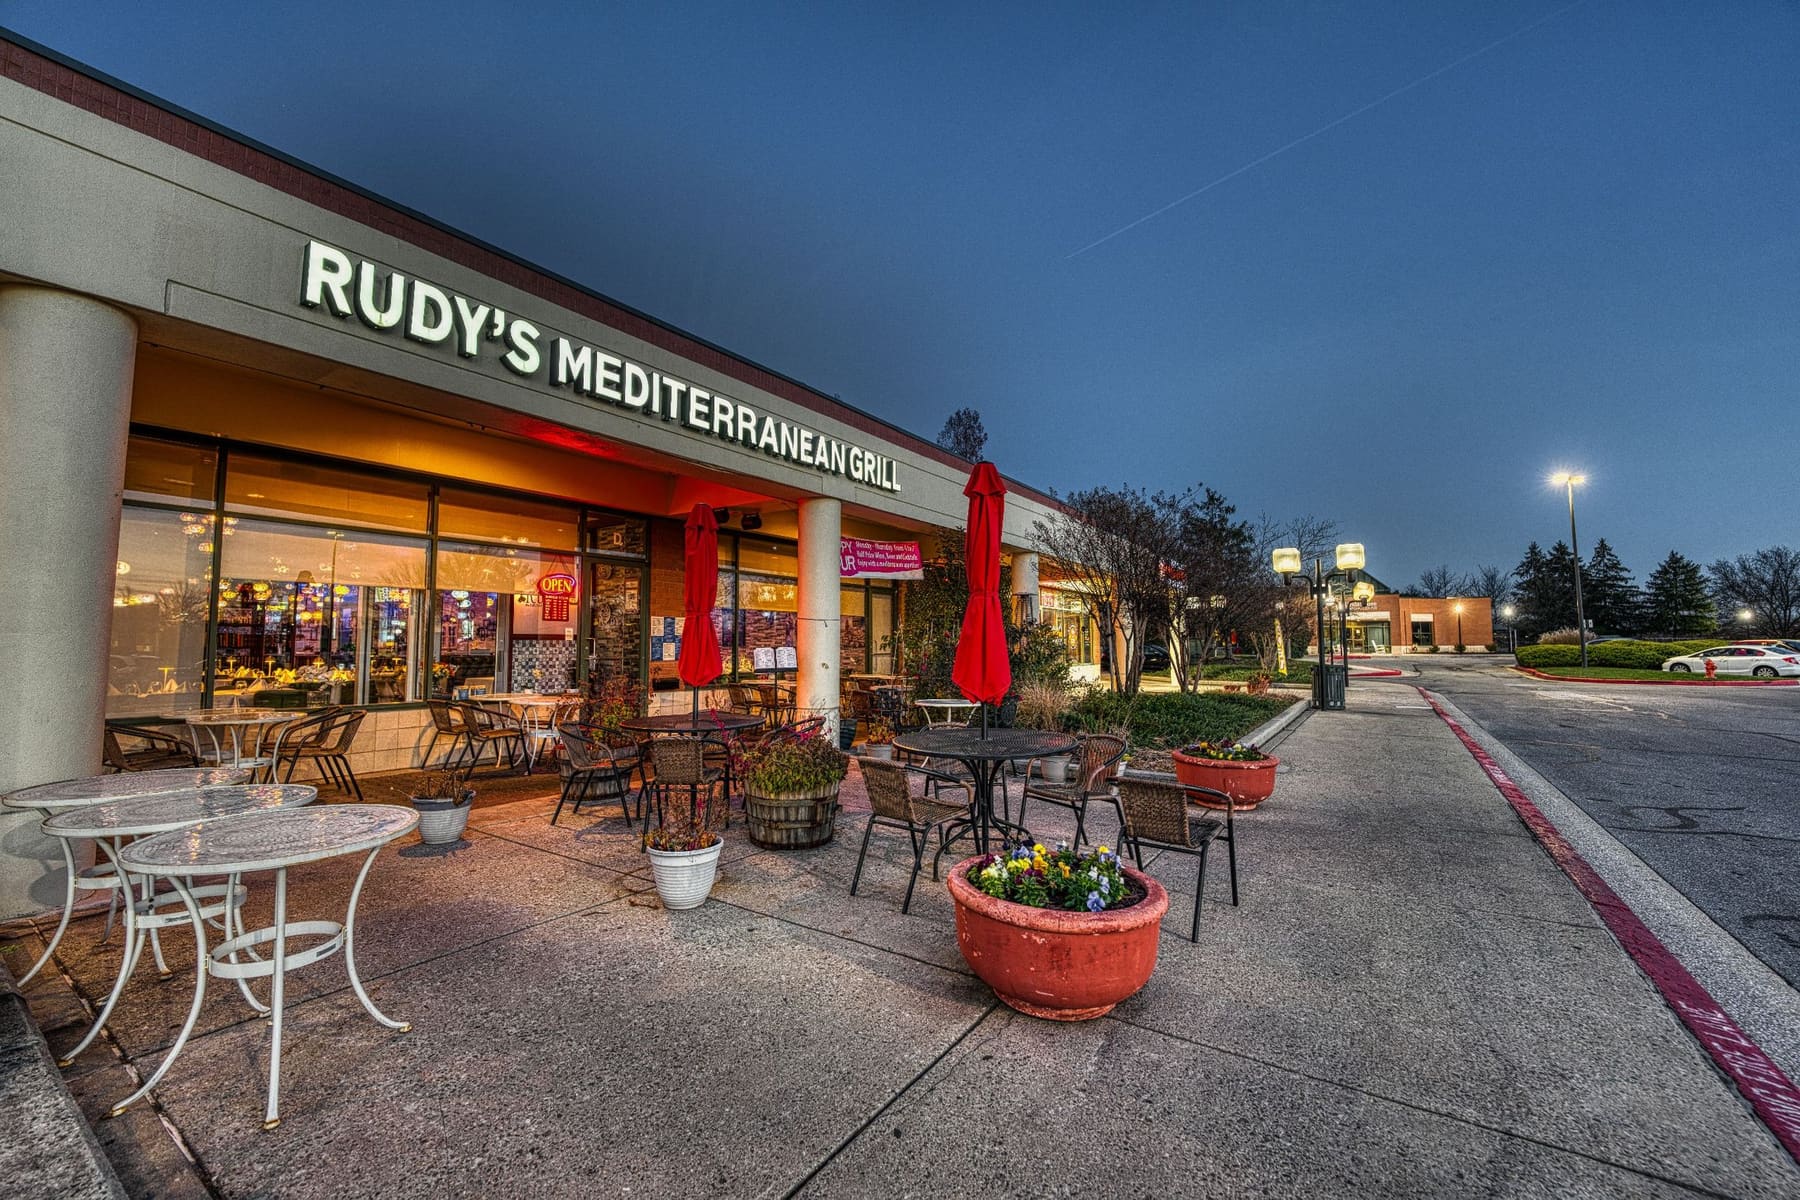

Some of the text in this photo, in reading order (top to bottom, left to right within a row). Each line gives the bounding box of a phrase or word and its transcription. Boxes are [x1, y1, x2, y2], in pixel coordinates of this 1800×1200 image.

[302, 240, 902, 492] RUDY'S MEDITERRANEAN GRILL
[840, 541, 852, 554] PY
[840, 555, 856, 571] UR
[542, 577, 572, 593] OPEN
[1678, 1000, 1752, 1048] LANE
